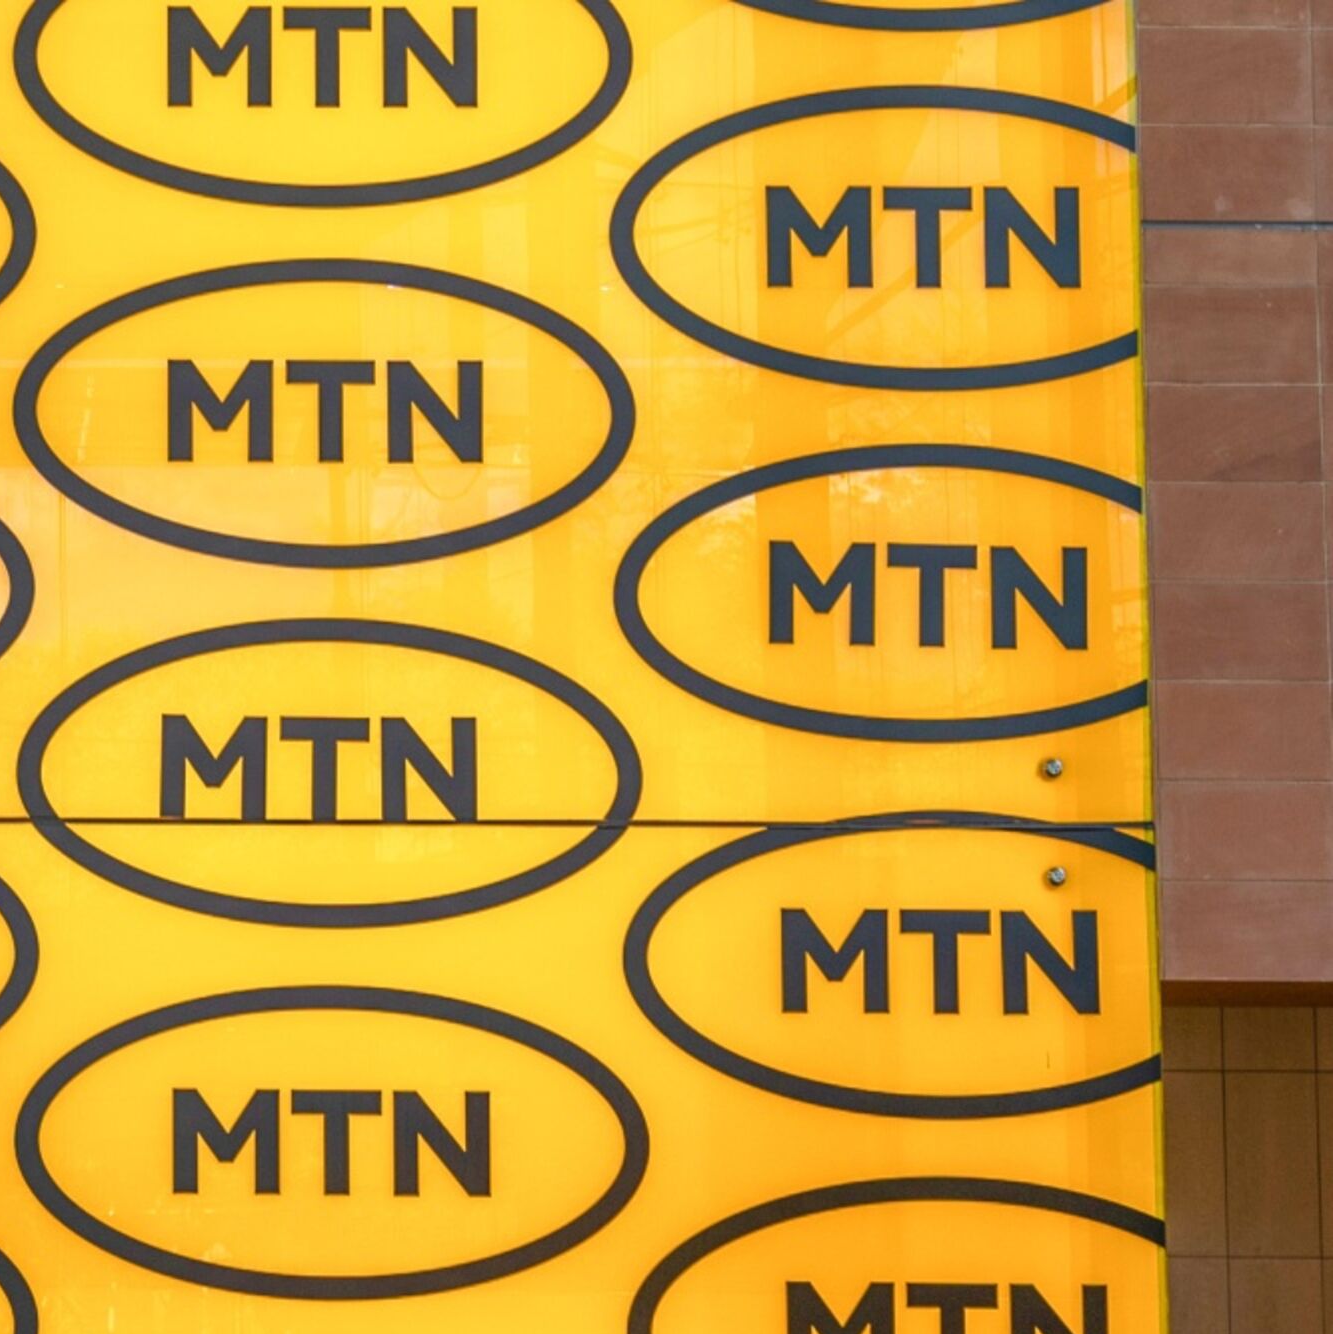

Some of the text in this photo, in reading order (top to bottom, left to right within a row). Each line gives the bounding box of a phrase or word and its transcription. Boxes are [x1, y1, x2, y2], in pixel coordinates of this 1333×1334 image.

[168, 6, 477, 108] MTN
[767, 186, 1081, 289] MTN
[168, 360, 483, 463] MTN
[769, 541, 1088, 650] MTN
[160, 713, 478, 822] MTN
[781, 908, 1100, 1015] MTN
[173, 1089, 490, 1196] MTN
